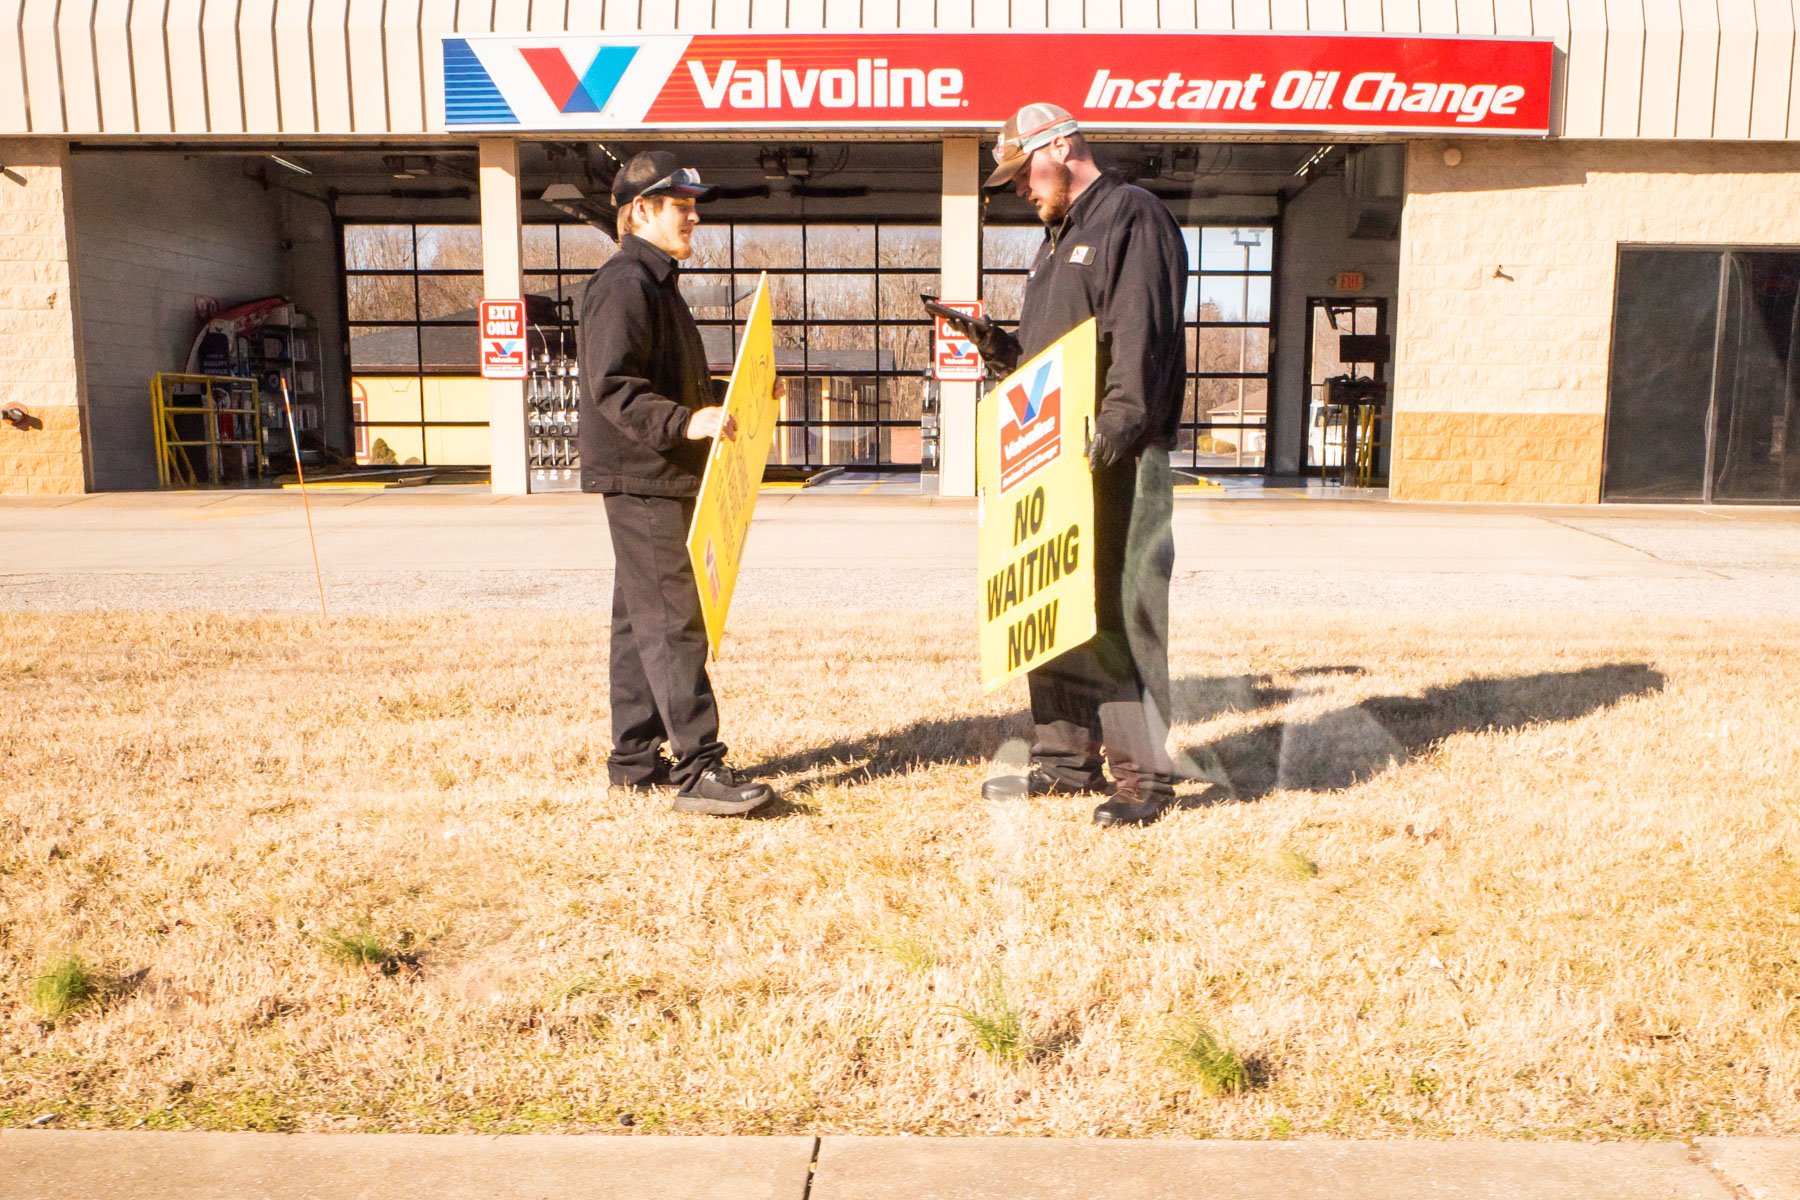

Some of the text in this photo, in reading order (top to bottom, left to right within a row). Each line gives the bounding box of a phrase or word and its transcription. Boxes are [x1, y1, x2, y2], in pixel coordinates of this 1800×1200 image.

[686, 58, 965, 109] Valvoline
[1084, 69, 1266, 110] Instant
[1342, 71, 1525, 123] Change
[486, 321, 519, 336] ONLY
[488, 305, 517, 320] EXIT
[1013, 486, 1045, 547] NO
[987, 523, 1080, 623] WAITING
[1008, 598, 1059, 673] NOW
